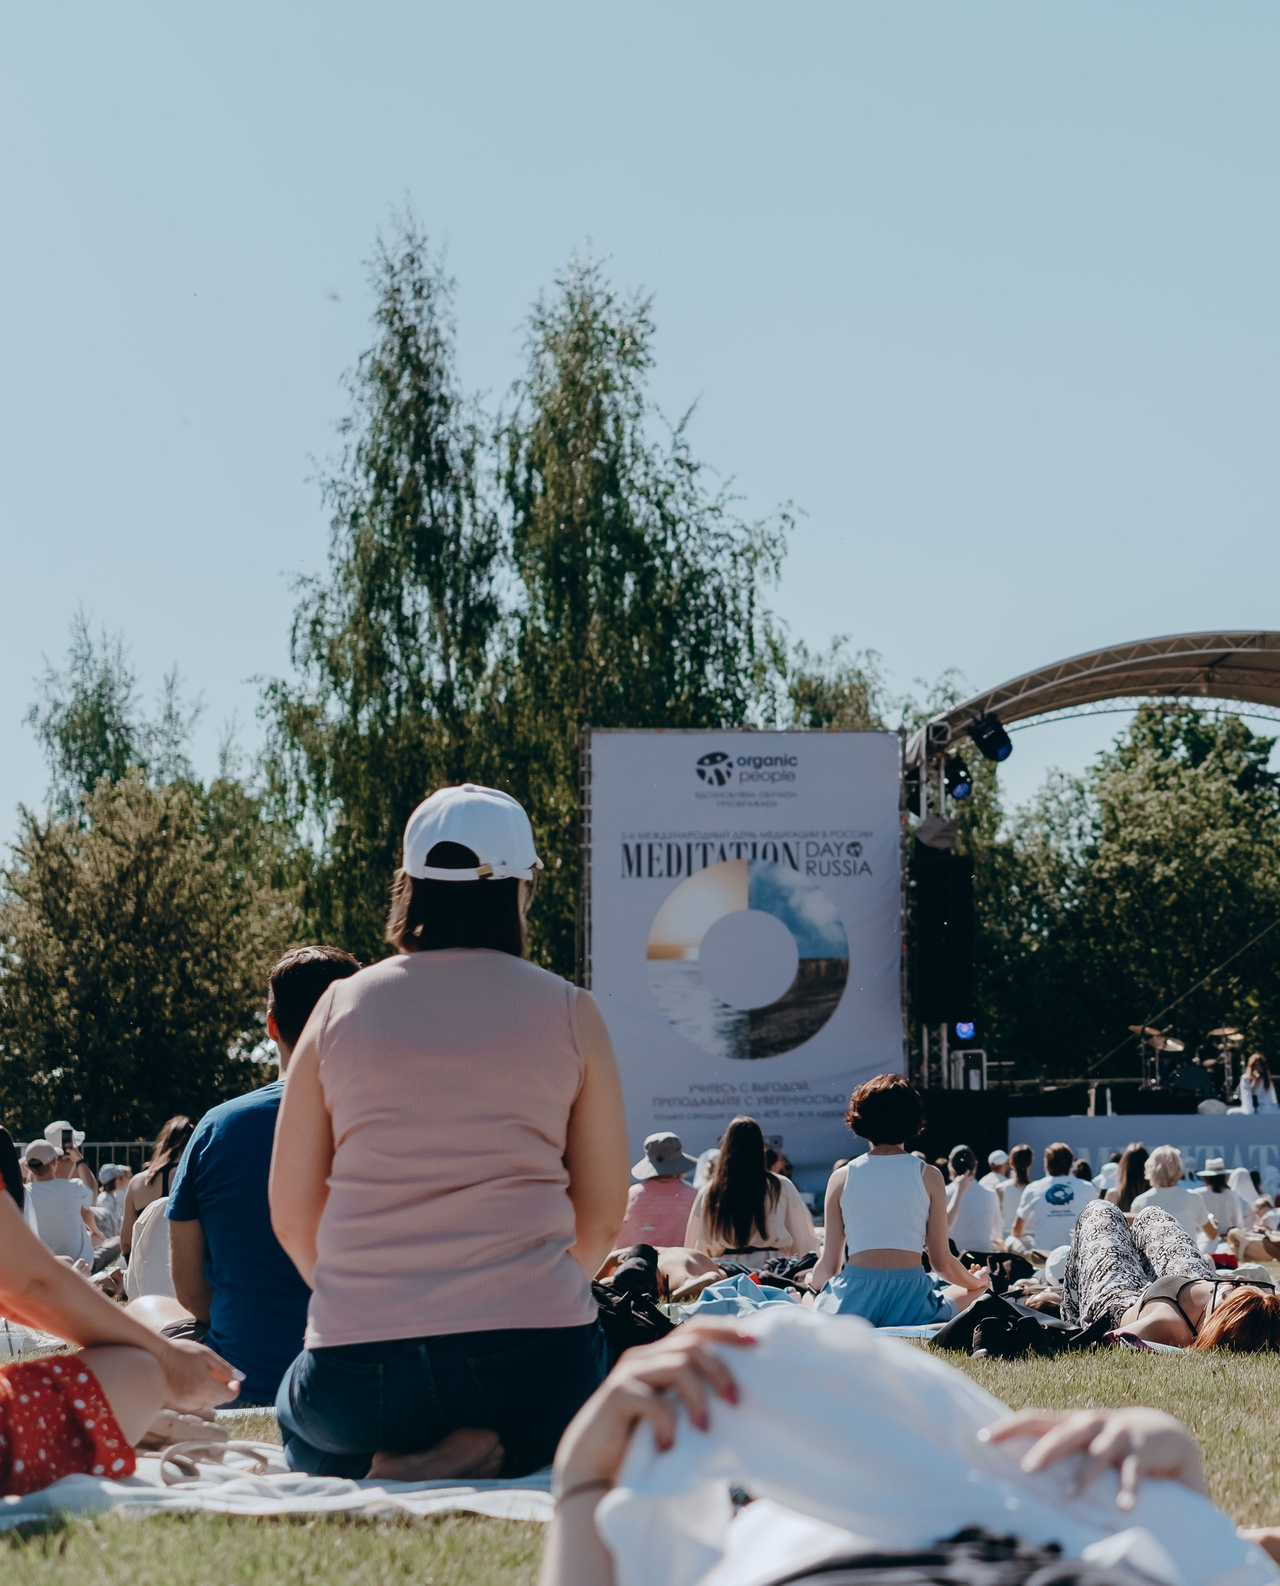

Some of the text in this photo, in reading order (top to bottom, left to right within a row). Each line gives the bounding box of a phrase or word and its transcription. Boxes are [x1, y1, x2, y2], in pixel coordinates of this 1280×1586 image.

[736, 753, 798, 769] organic
[739, 769, 796, 784] people
[638, 830, 730, 840] МЕЖДУНАРОДНЫЙ
[733, 830, 757, 839] ДЕНЬ
[759, 830, 819, 839] МЕДИТАЦИИ
[830, 829, 873, 839] РОССИИ
[806, 841, 844, 858] DAY
[806, 859, 873, 876] RUSSIA
[688, 1082, 736, 1094] УЧИТЕСЬ
[739, 1081, 749, 1093] С
[652, 1093, 847, 1107] ПРЕПОДАВАЙТЕ С УВЕРЕННОСТЬЮ
